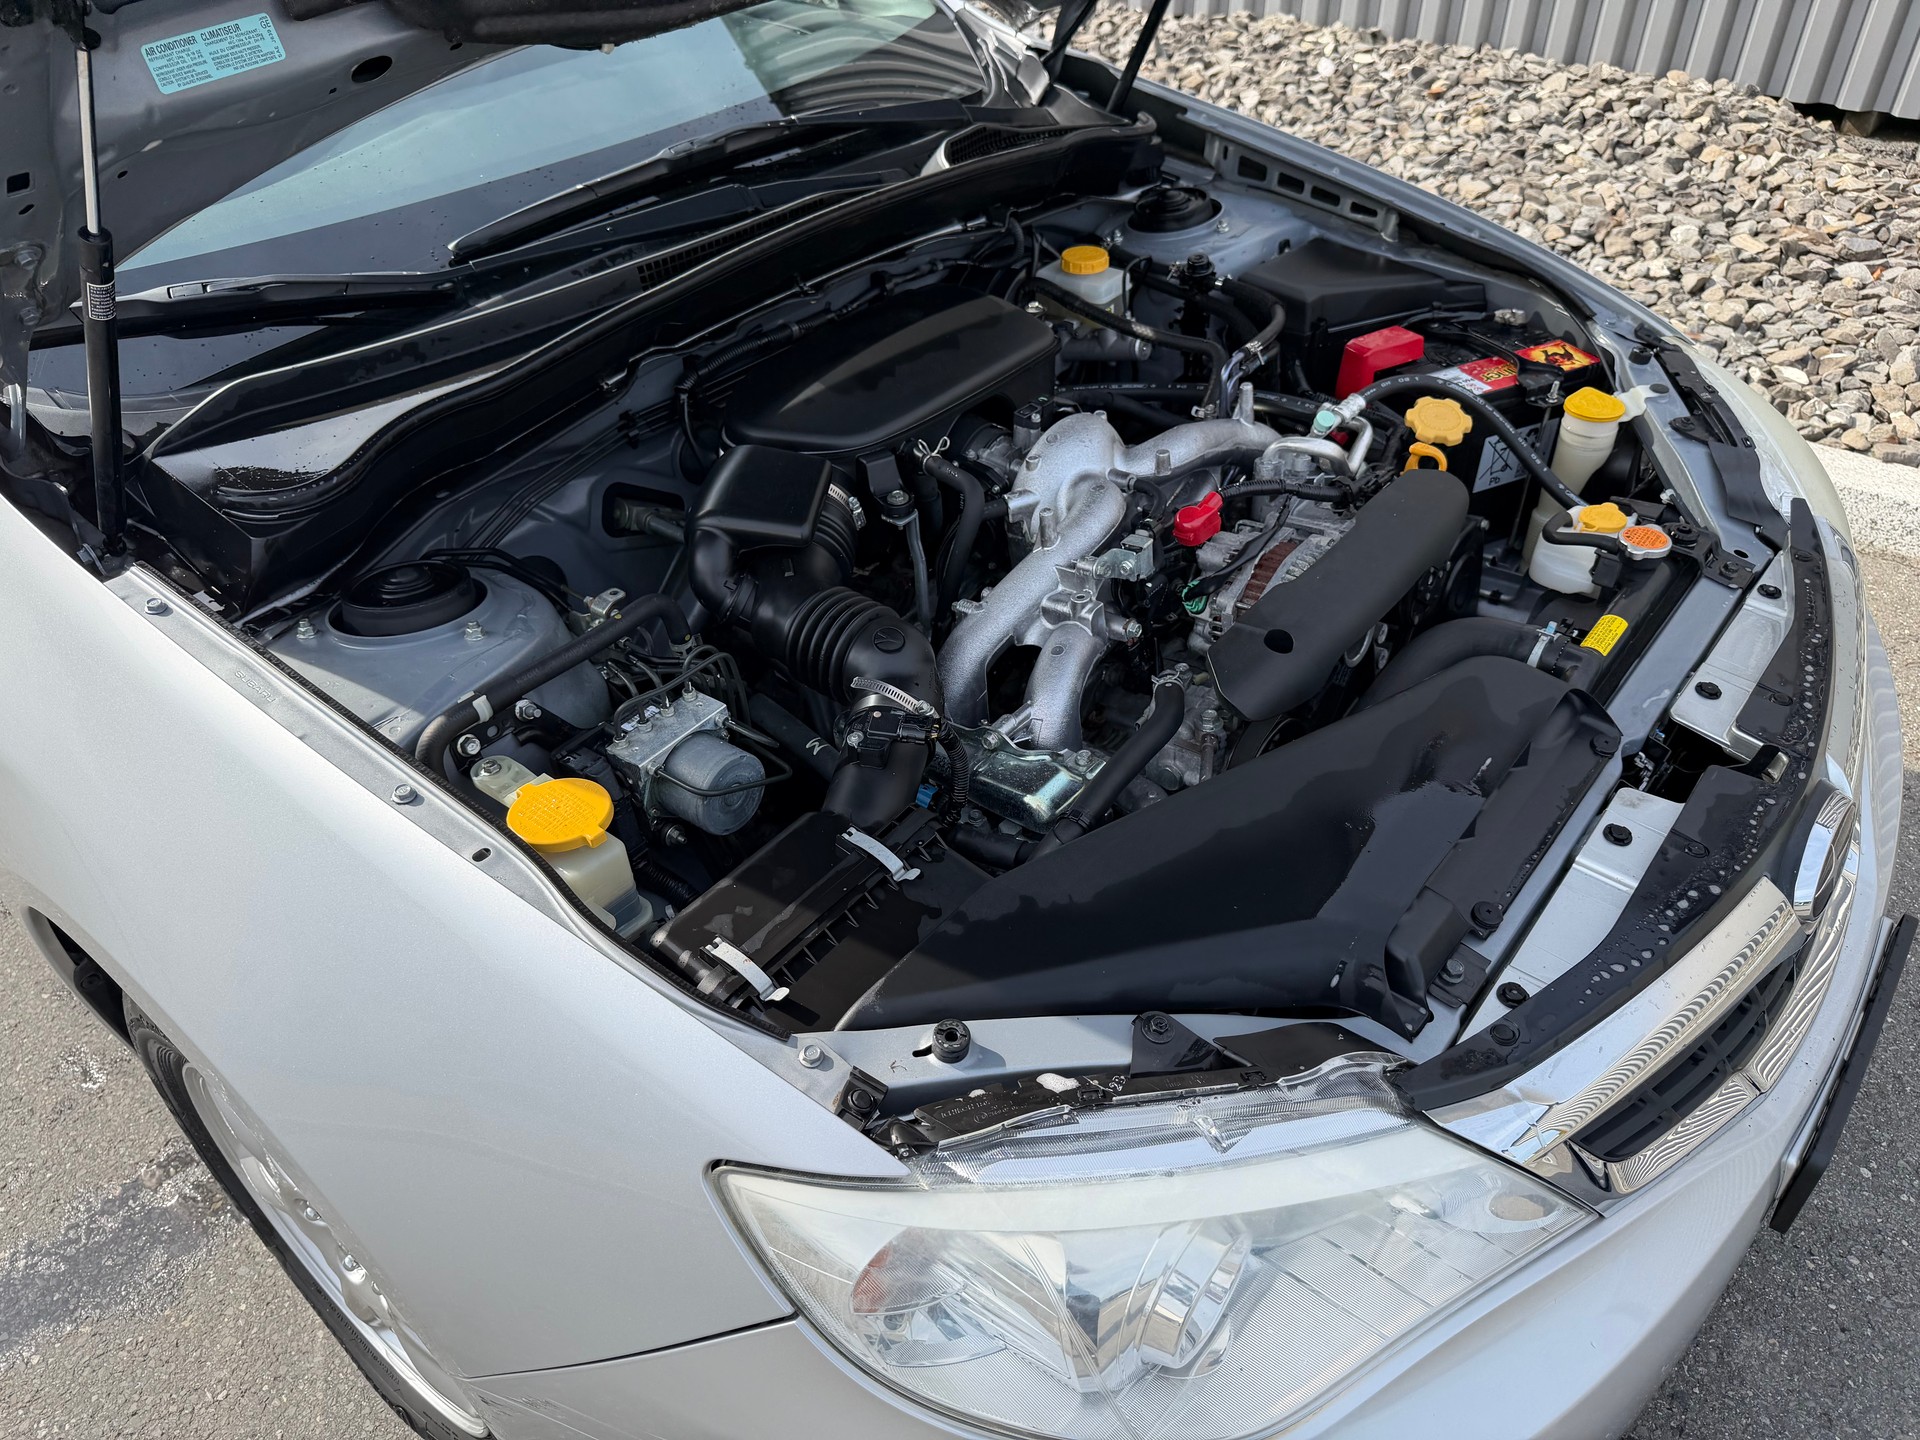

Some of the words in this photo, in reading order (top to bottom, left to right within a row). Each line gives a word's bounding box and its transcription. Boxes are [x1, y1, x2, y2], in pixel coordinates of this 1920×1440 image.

[200, 23, 242, 42] CLIMATISEUR
[259, 19, 272, 30] GE
[144, 46, 157, 57] AIR
[155, 35, 198, 54] CONDITIONER
[1489, 477, 1501, 486] Pb
[235, 671, 277, 703] SUBARU
